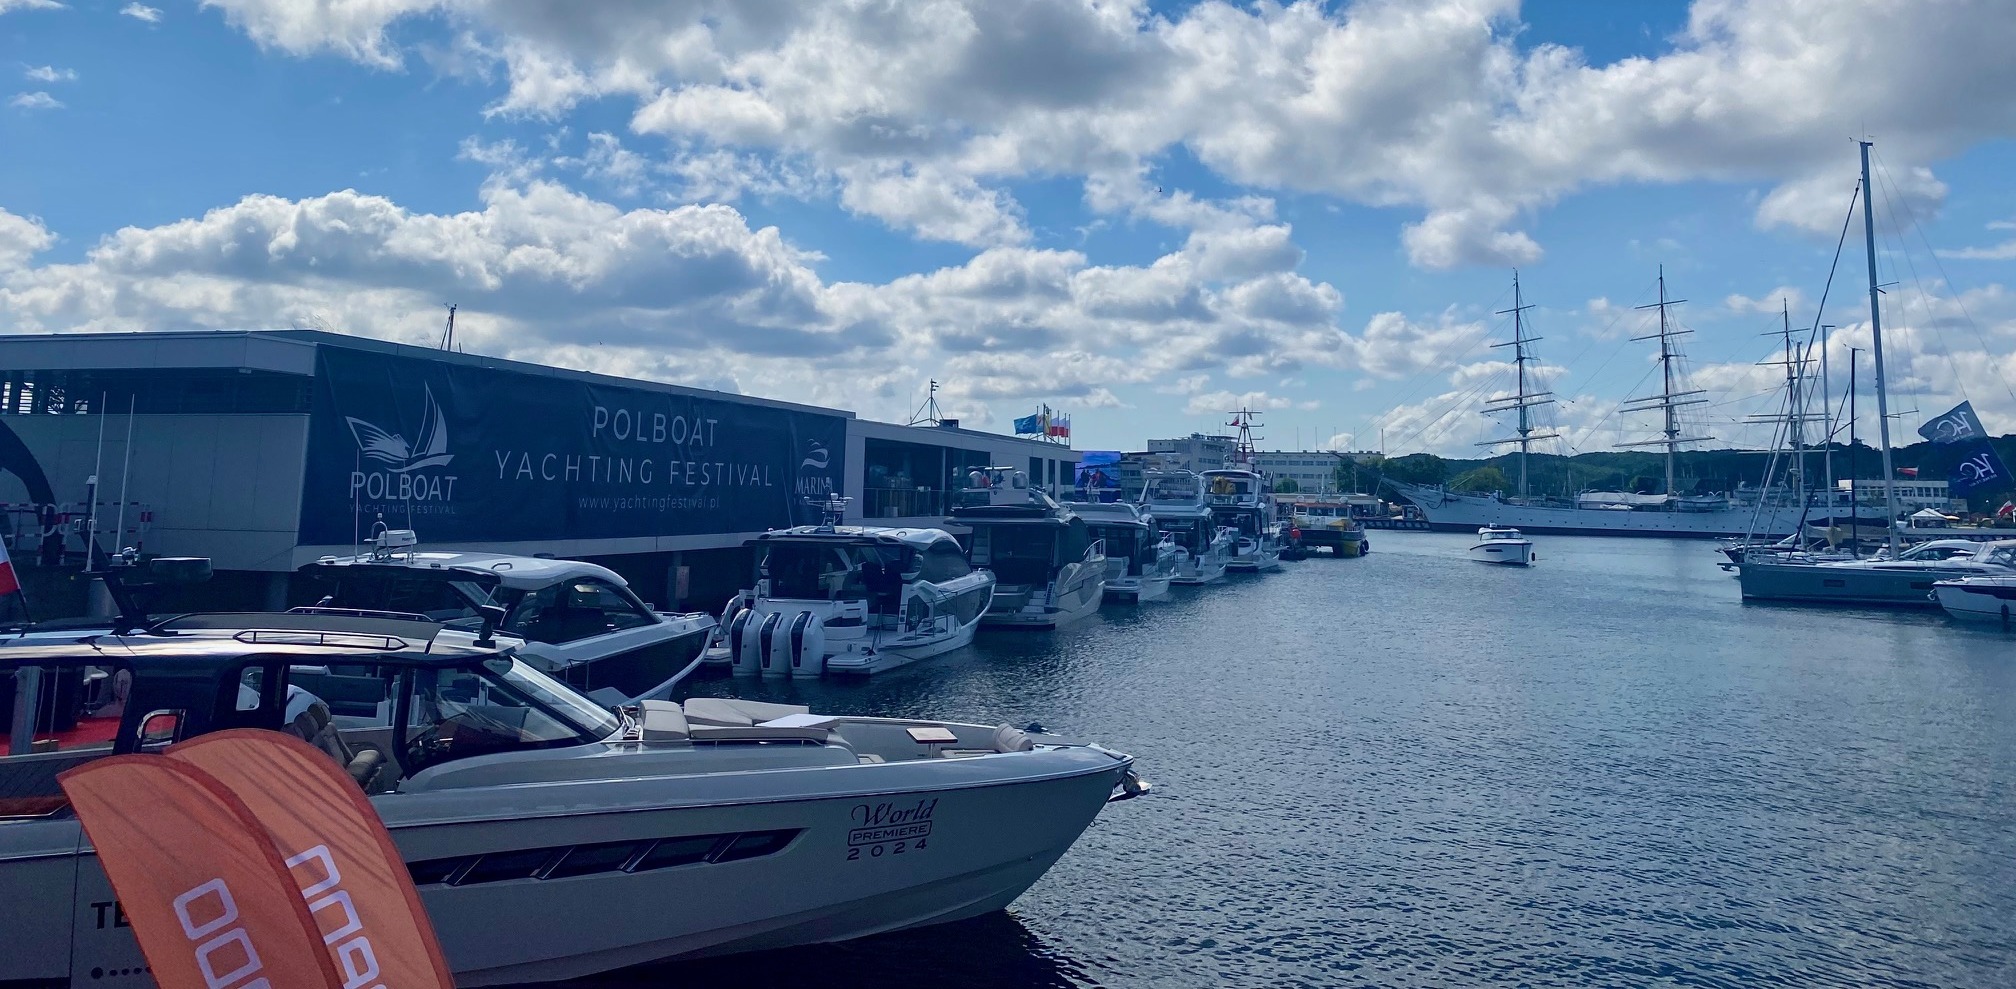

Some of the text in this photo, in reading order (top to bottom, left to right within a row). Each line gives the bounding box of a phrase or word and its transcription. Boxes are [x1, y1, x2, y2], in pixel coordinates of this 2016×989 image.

[593, 405, 718, 447] POLBOAT
[495, 449, 773, 486] YACHTING FESTIVAL
[349, 471, 458, 501] POLBOAT
[349, 503, 456, 515] YACHTING FESTIVAL
[578, 494, 720, 512] www.yachtingfestival.pl
[851, 798, 939, 826] World
[852, 824, 928, 842] PREMIERE
[846, 838, 927, 861] 2024
